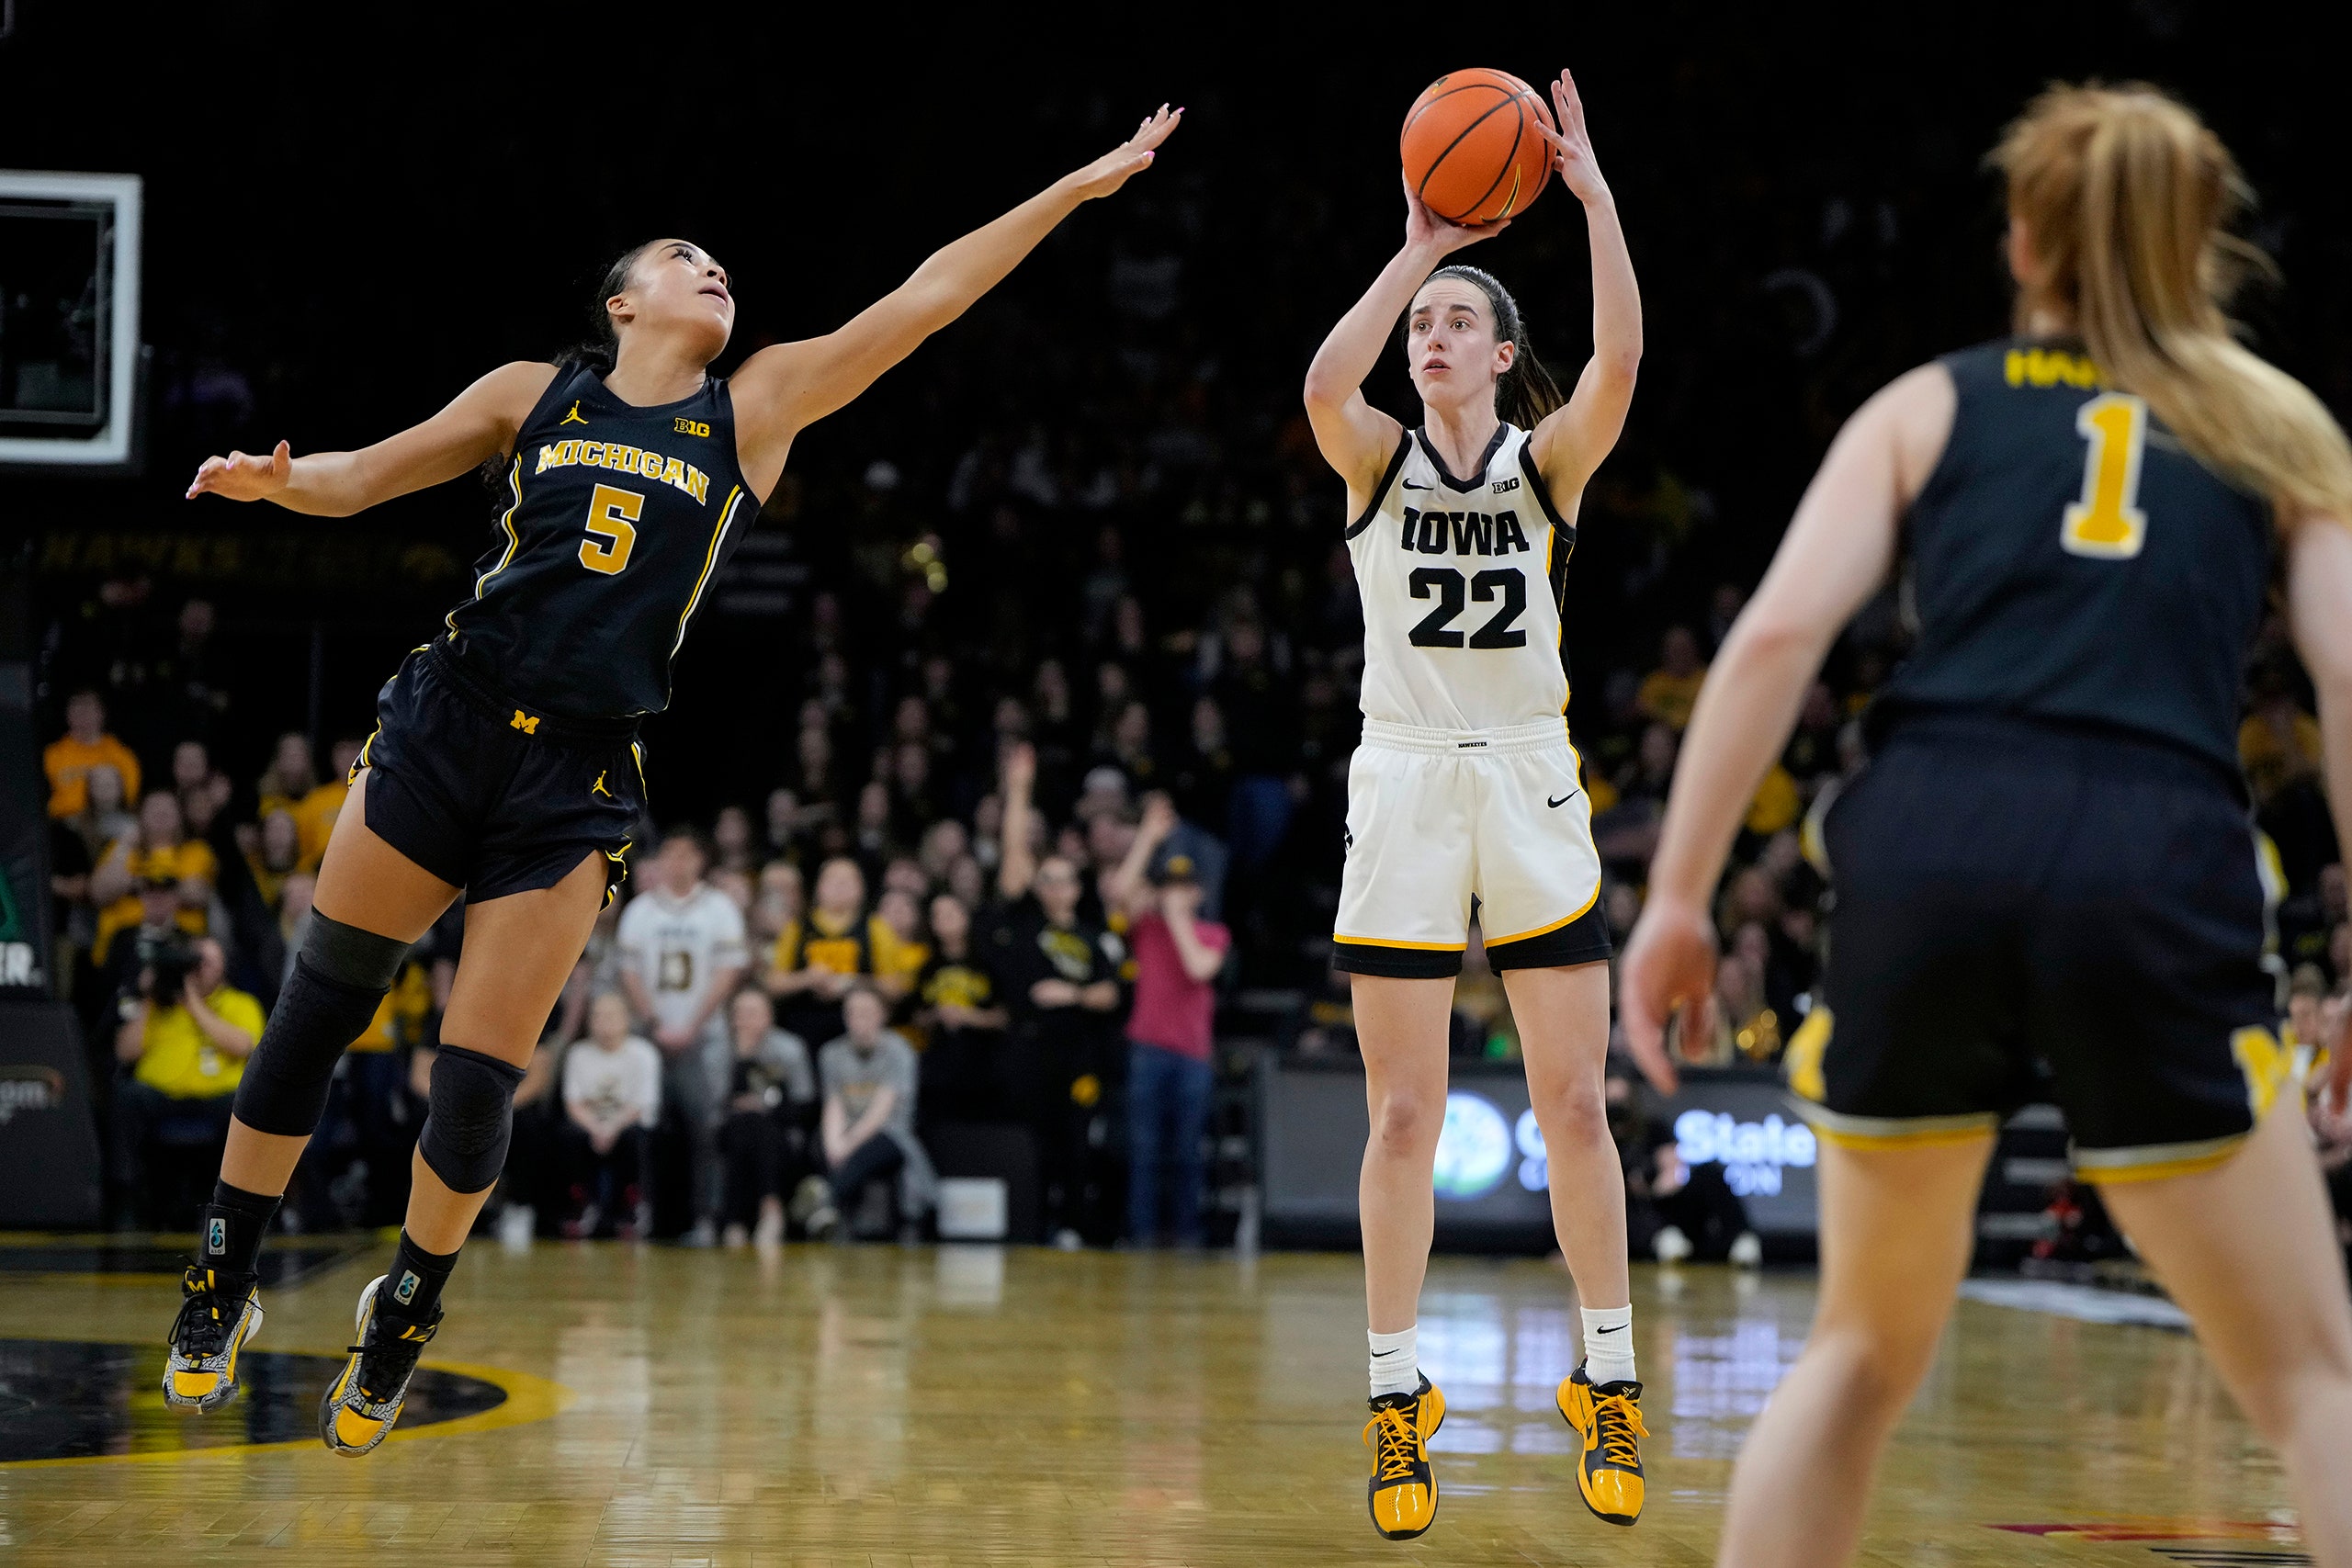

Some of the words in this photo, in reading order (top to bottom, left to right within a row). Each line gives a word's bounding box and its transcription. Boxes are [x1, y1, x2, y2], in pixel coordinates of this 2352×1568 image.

[535, 439, 710, 506] MICHIGAN
[2060, 391, 2147, 559] 1
[578, 483, 645, 576] 5
[1400, 506, 1530, 556] IOWA
[1408, 567, 1527, 649] 22
[510, 709, 540, 735] M
